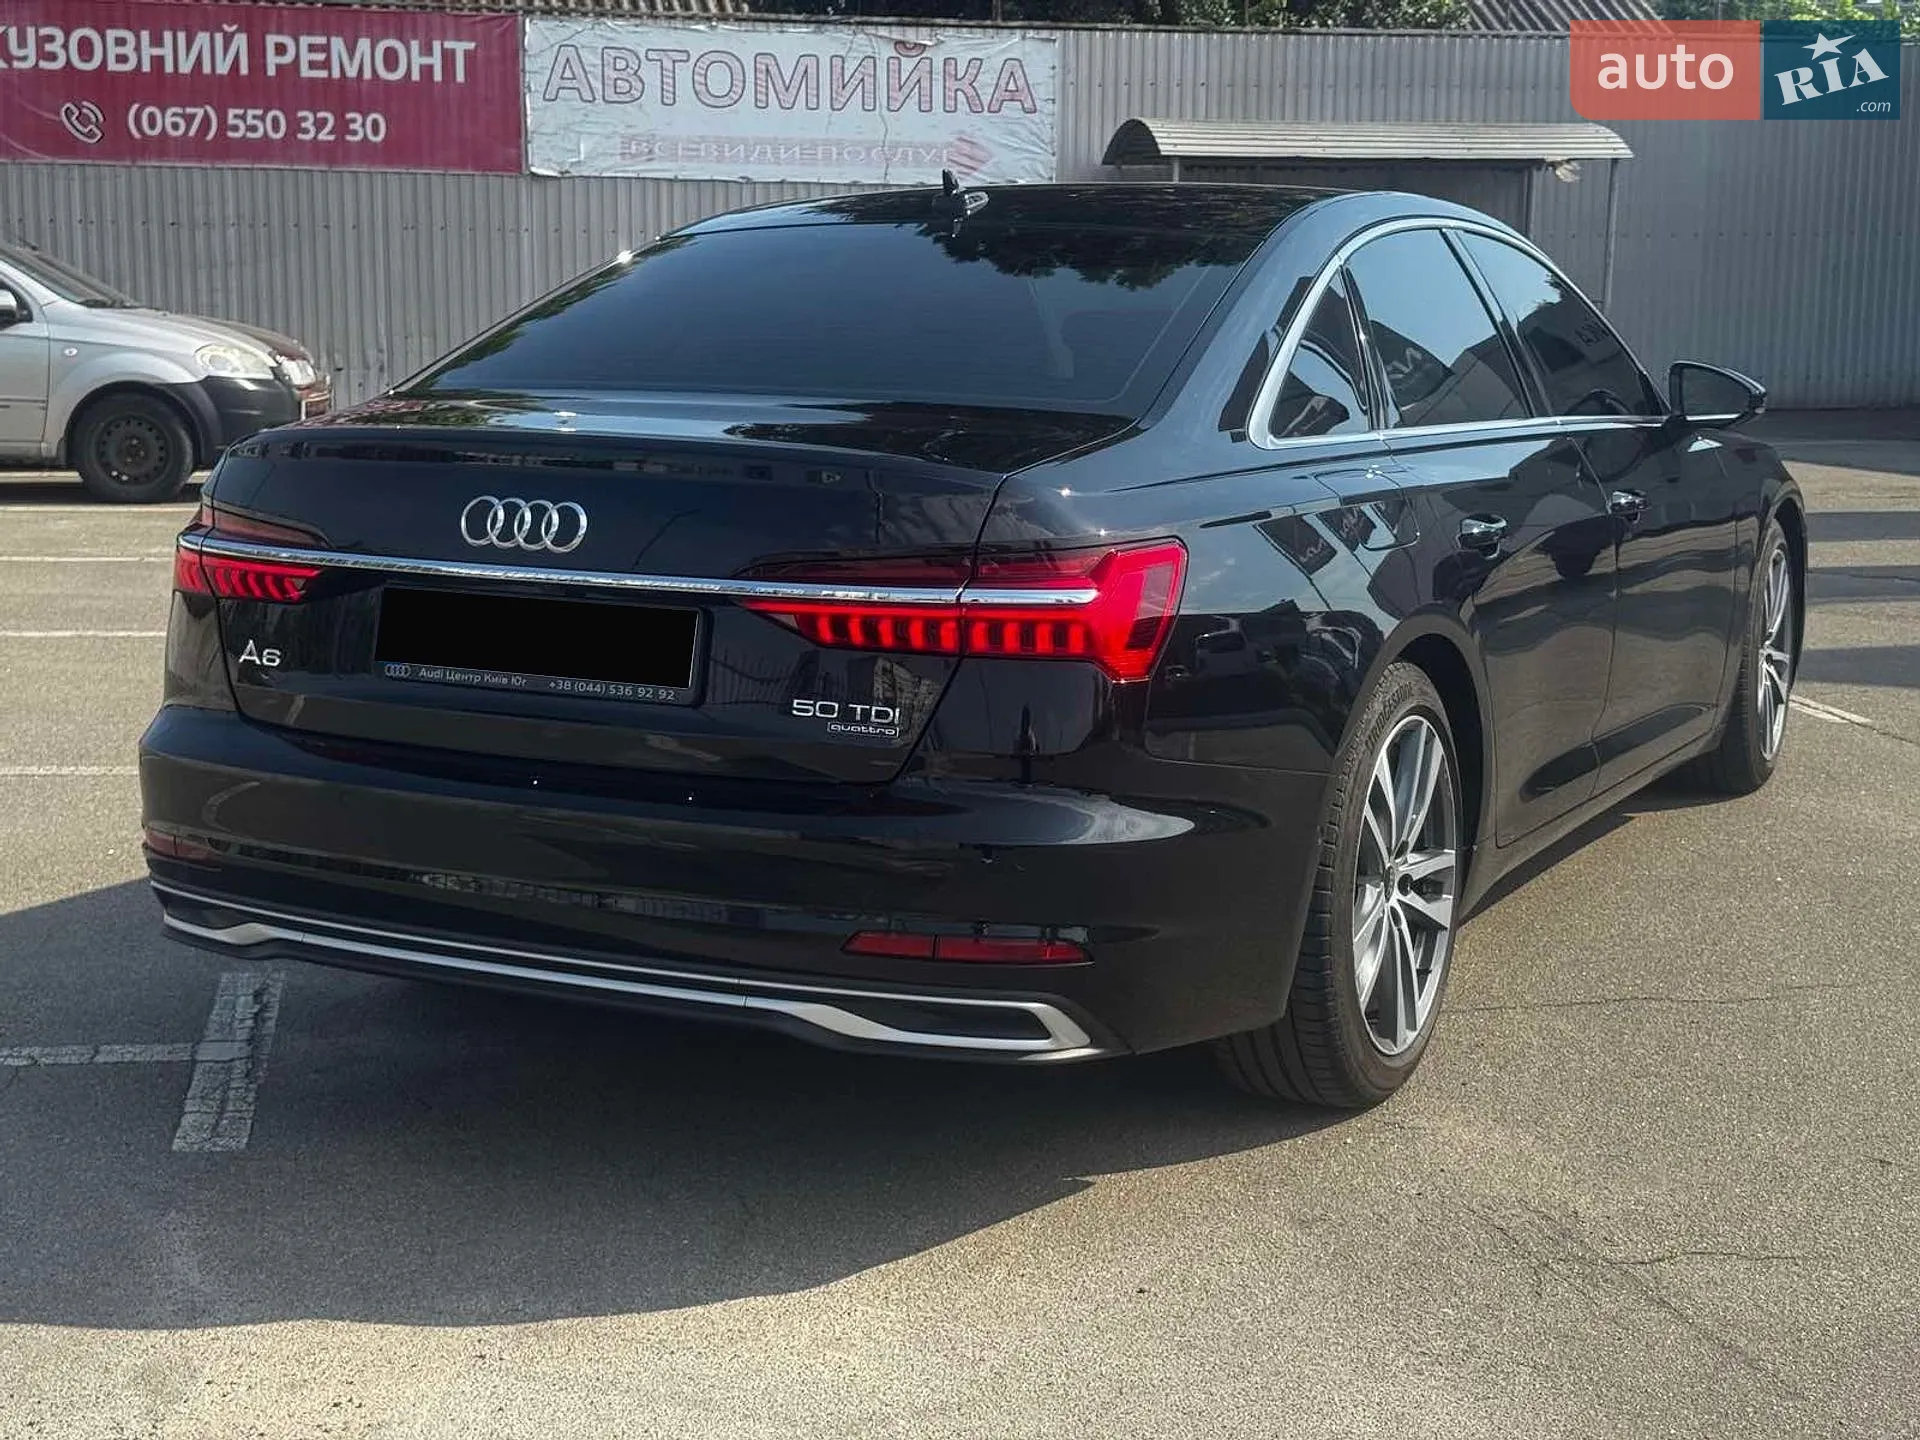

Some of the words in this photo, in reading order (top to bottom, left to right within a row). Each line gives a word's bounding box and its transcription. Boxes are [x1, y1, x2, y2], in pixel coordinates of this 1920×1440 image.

[265, 34, 477, 83] РЕМОНТ
[543, 41, 1037, 114] АВТОМИЙКА
[127, 103, 218, 141] (067)
[227, 107, 286, 140] 550
[296, 112, 336, 142] 32
[345, 112, 387, 143] 30
[238, 638, 281, 667] A6
[419, 667, 443, 680] Audi
[446, 670, 481, 684] Центр
[548, 680, 571, 690] +38
[574, 681, 606, 695] (044)
[608, 685, 633, 696] 536
[637, 687, 654, 698] 92
[658, 689, 675, 700] 92
[791, 698, 839, 718] 50
[848, 703, 900, 724] TDI
